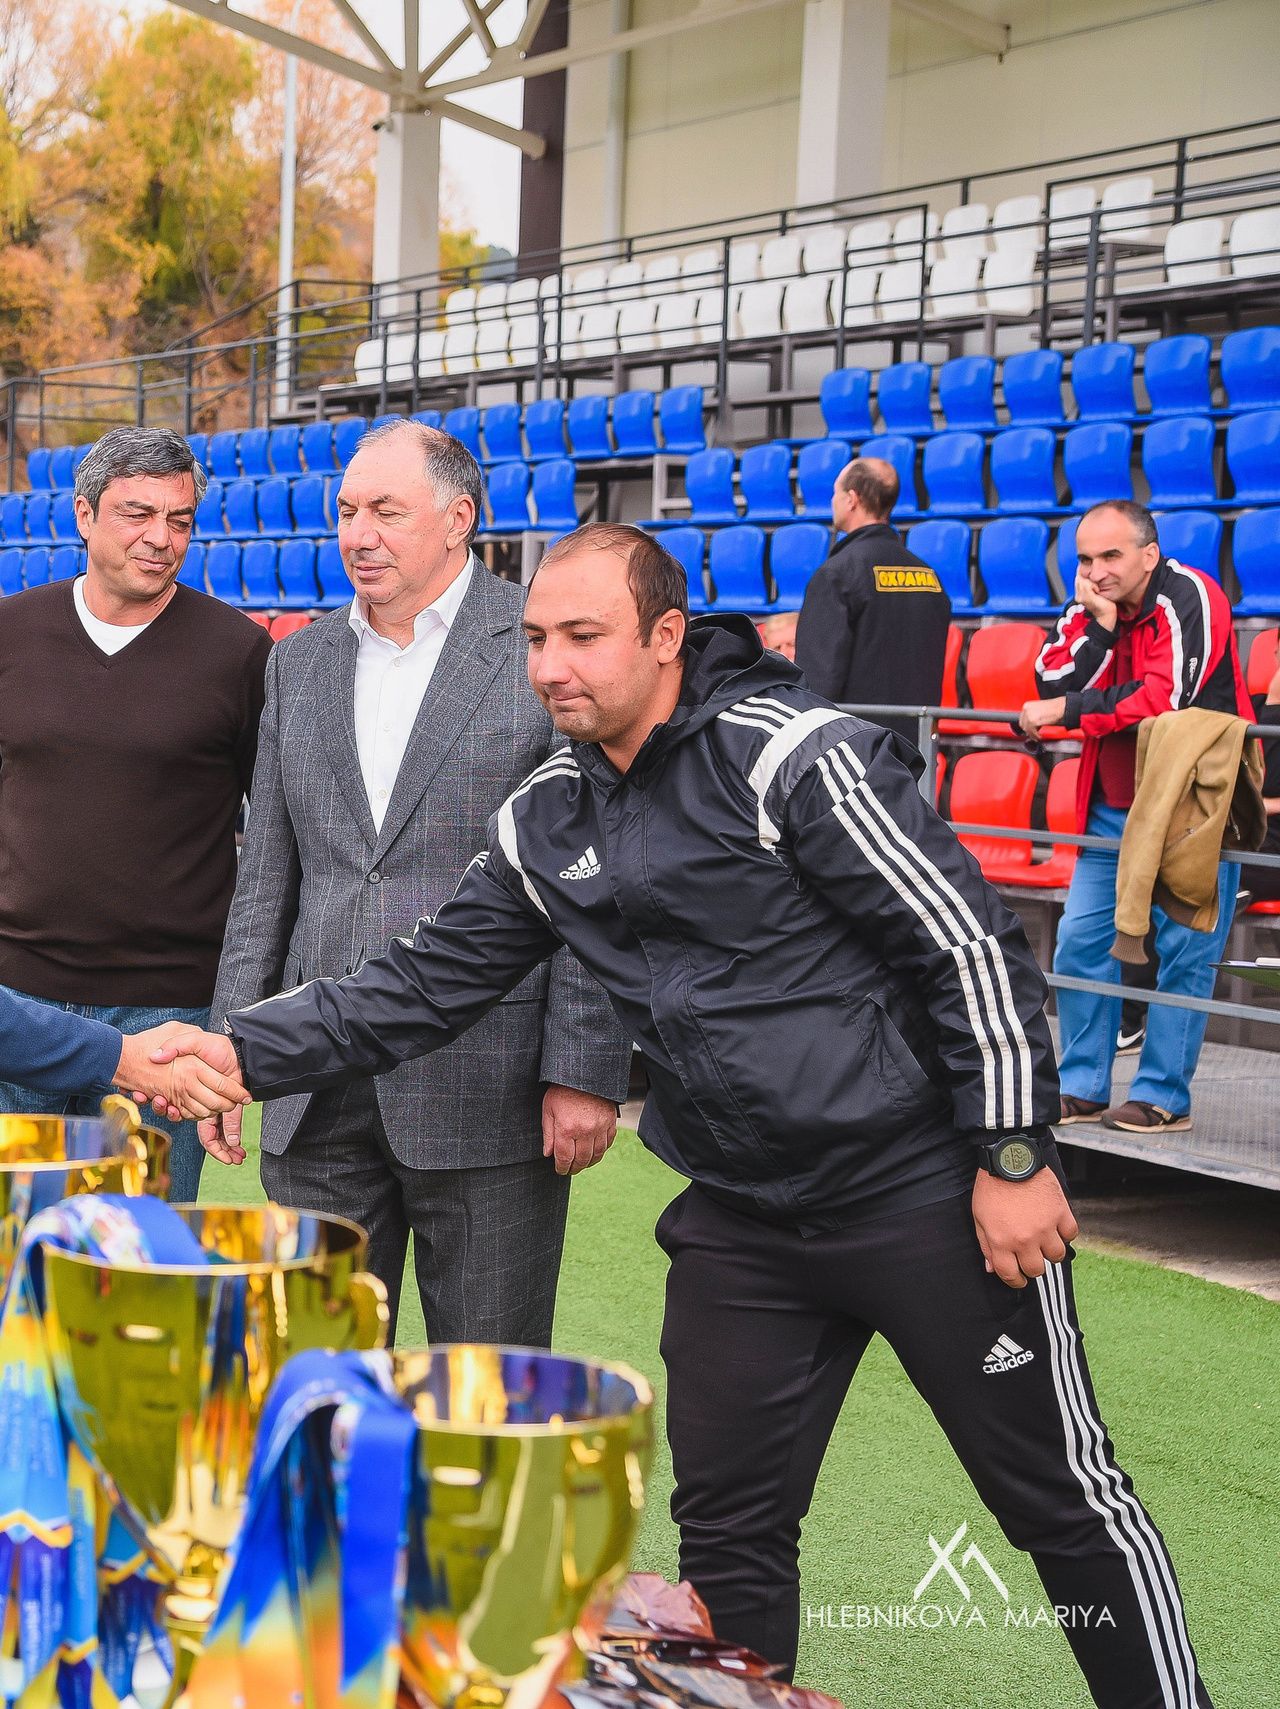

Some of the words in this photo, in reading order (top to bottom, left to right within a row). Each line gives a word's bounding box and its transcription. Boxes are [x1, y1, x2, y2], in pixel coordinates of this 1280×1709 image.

[879, 571, 938, 587] ОХРАНА
[558, 863, 602, 880] adidas
[982, 1350, 1035, 1374] adidas
